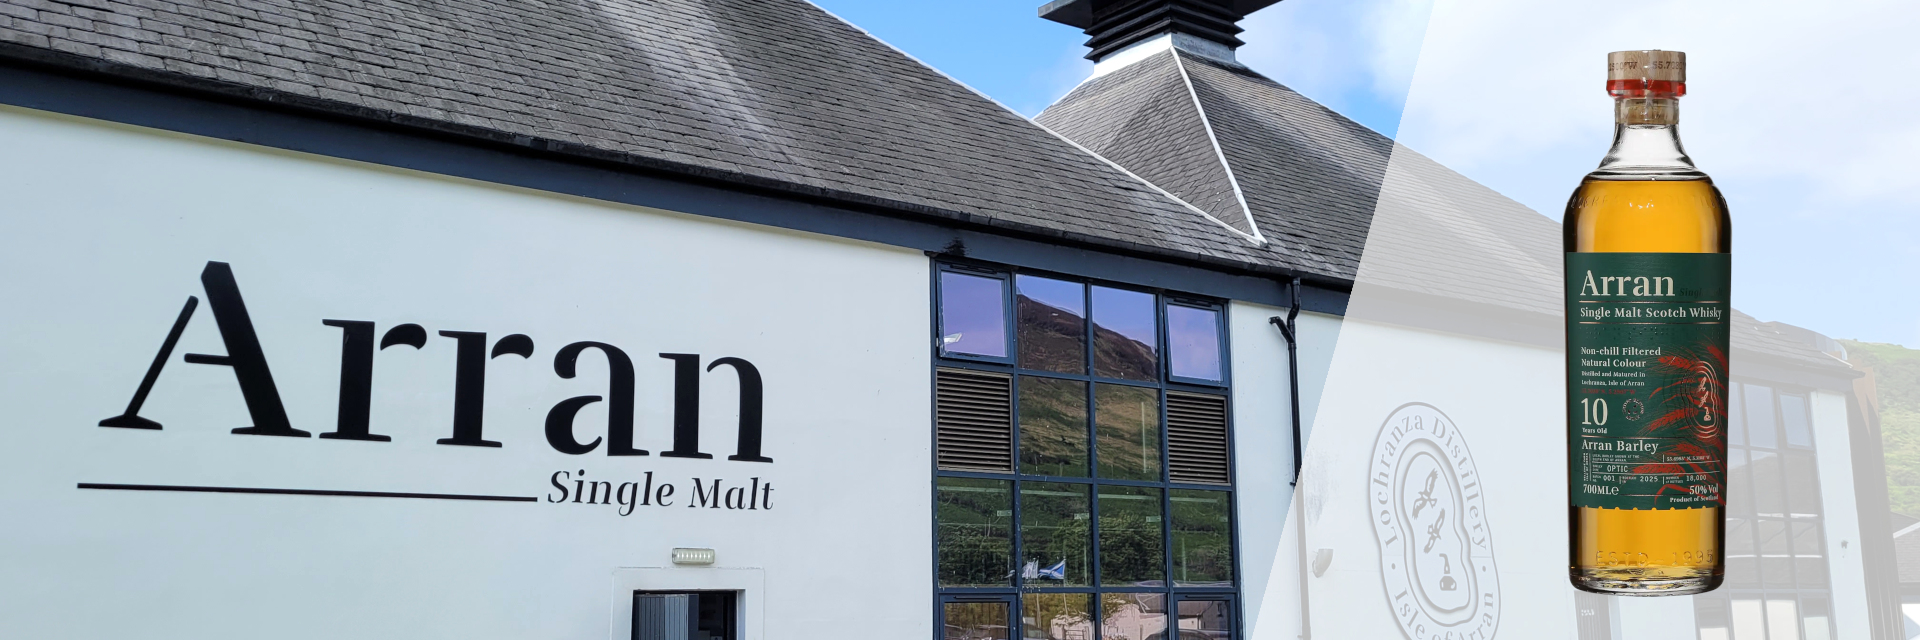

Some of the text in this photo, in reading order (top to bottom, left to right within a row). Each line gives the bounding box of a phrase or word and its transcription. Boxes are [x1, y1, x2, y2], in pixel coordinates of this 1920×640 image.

[1580, 269, 1676, 297] Arran
[1580, 306, 1722, 320] Single Malt Scotch Whisky
[1580, 346, 1661, 356] Non-chill Filtered
[98, 260, 774, 463] Arran
[1581, 358, 1647, 368] Natural Colour
[1581, 397, 1608, 426] 10
[1581, 439, 1659, 455] Arran Barley
[1607, 465, 1629, 473] OPTIC
[1373, 414, 1487, 550] Lochranza Distillery
[1639, 475, 1659, 483] 2025
[1686, 474, 1707, 482] 18,000
[546, 469, 775, 517] Single Malt
[1689, 483, 1719, 495] 50% Vol
[1596, 550, 1649, 567] ESTD
[1394, 587, 1426, 640] Isle
